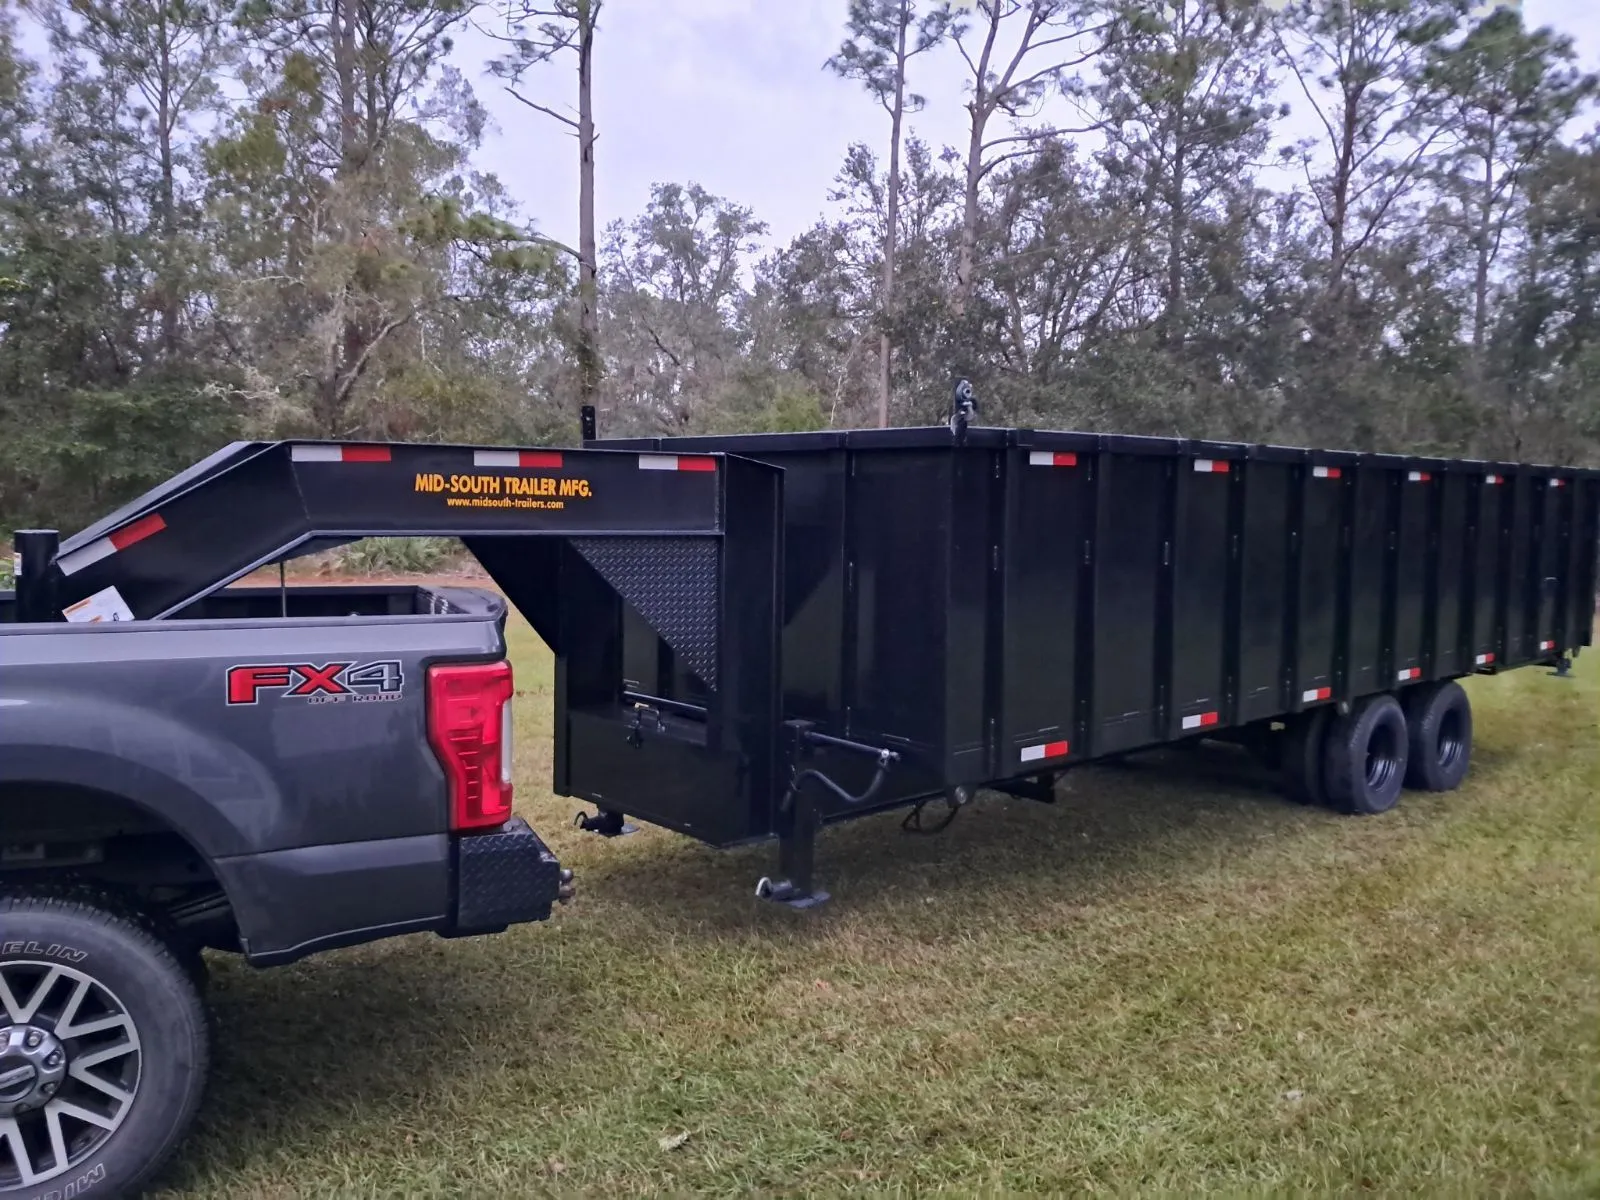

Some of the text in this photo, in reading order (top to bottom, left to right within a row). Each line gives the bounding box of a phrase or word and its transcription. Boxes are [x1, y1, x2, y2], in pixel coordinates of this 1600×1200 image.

[415, 473, 592, 497] MID-SOUTH TRAILER MFG.
[447, 496, 564, 509] www.midsouth-trailers.com
[226, 659, 405, 706] FX4
[308, 693, 403, 704] OFF ROAD
